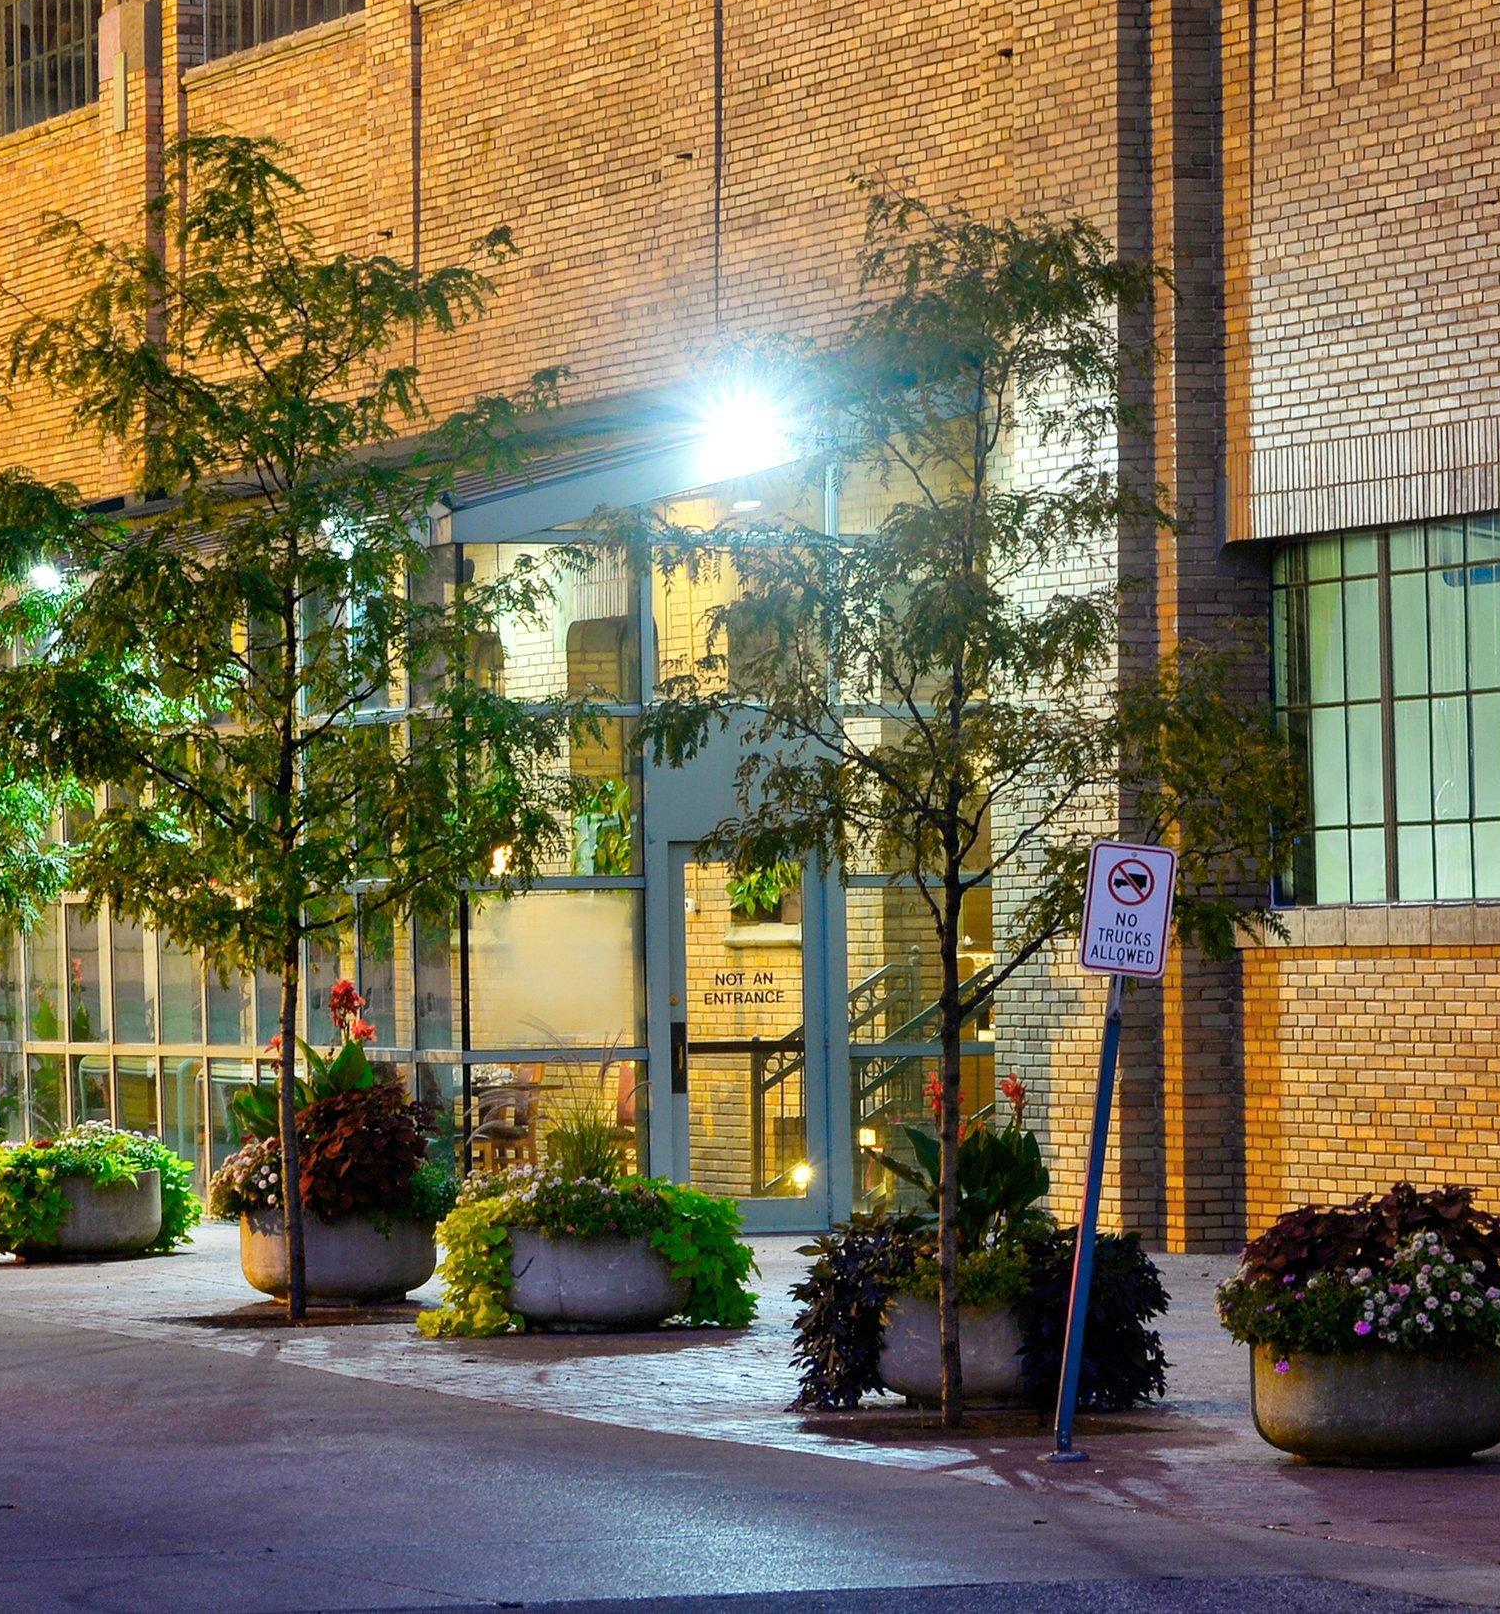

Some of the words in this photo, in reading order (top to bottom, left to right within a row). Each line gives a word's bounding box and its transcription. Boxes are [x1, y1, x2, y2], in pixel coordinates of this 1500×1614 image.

[1115, 912, 1138, 928] NO
[1098, 927, 1152, 947] TRUCKS
[1090, 944, 1154, 965] ALLOWED
[715, 972, 746, 986] NOT
[753, 972, 774, 985] AN
[704, 990, 786, 1005] ENTRANCE
